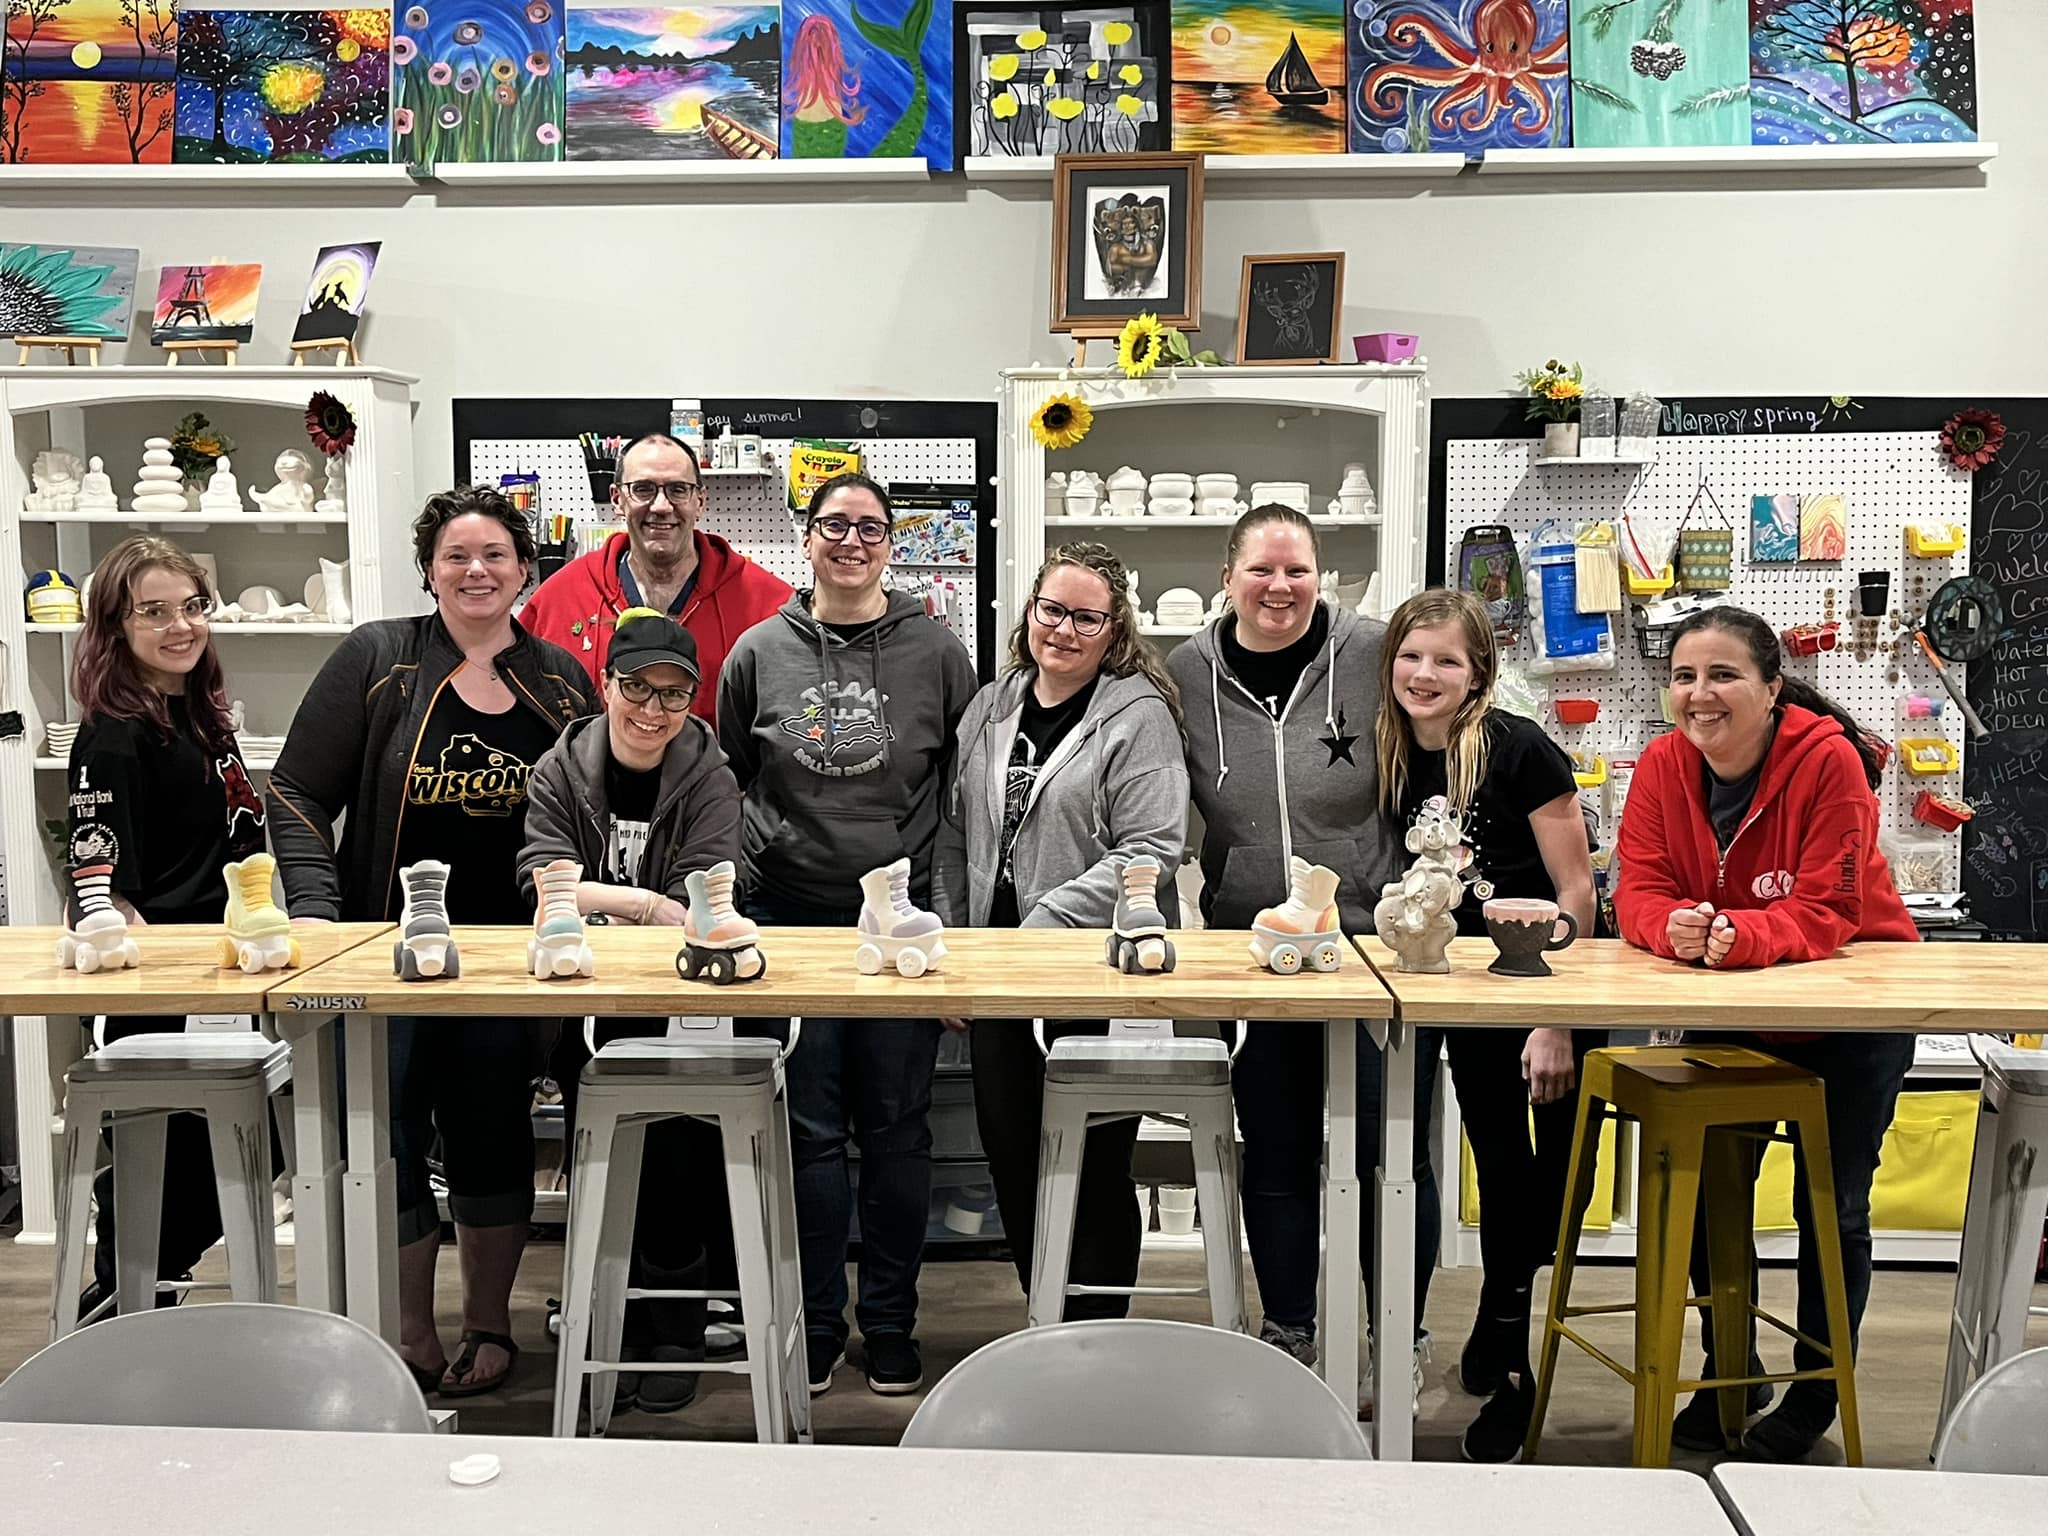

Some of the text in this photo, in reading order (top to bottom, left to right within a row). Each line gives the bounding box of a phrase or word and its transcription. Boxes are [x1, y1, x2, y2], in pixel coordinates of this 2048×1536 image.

[805, 452, 842, 465] Crayola
[953, 503, 970, 513] 30
[1995, 665, 2032, 684] HOT
[1993, 688, 2031, 711] HOT
[1990, 750, 2043, 790] HELP
[408, 765, 536, 804] WISCON
[306, 995, 366, 1010] HUSKY
